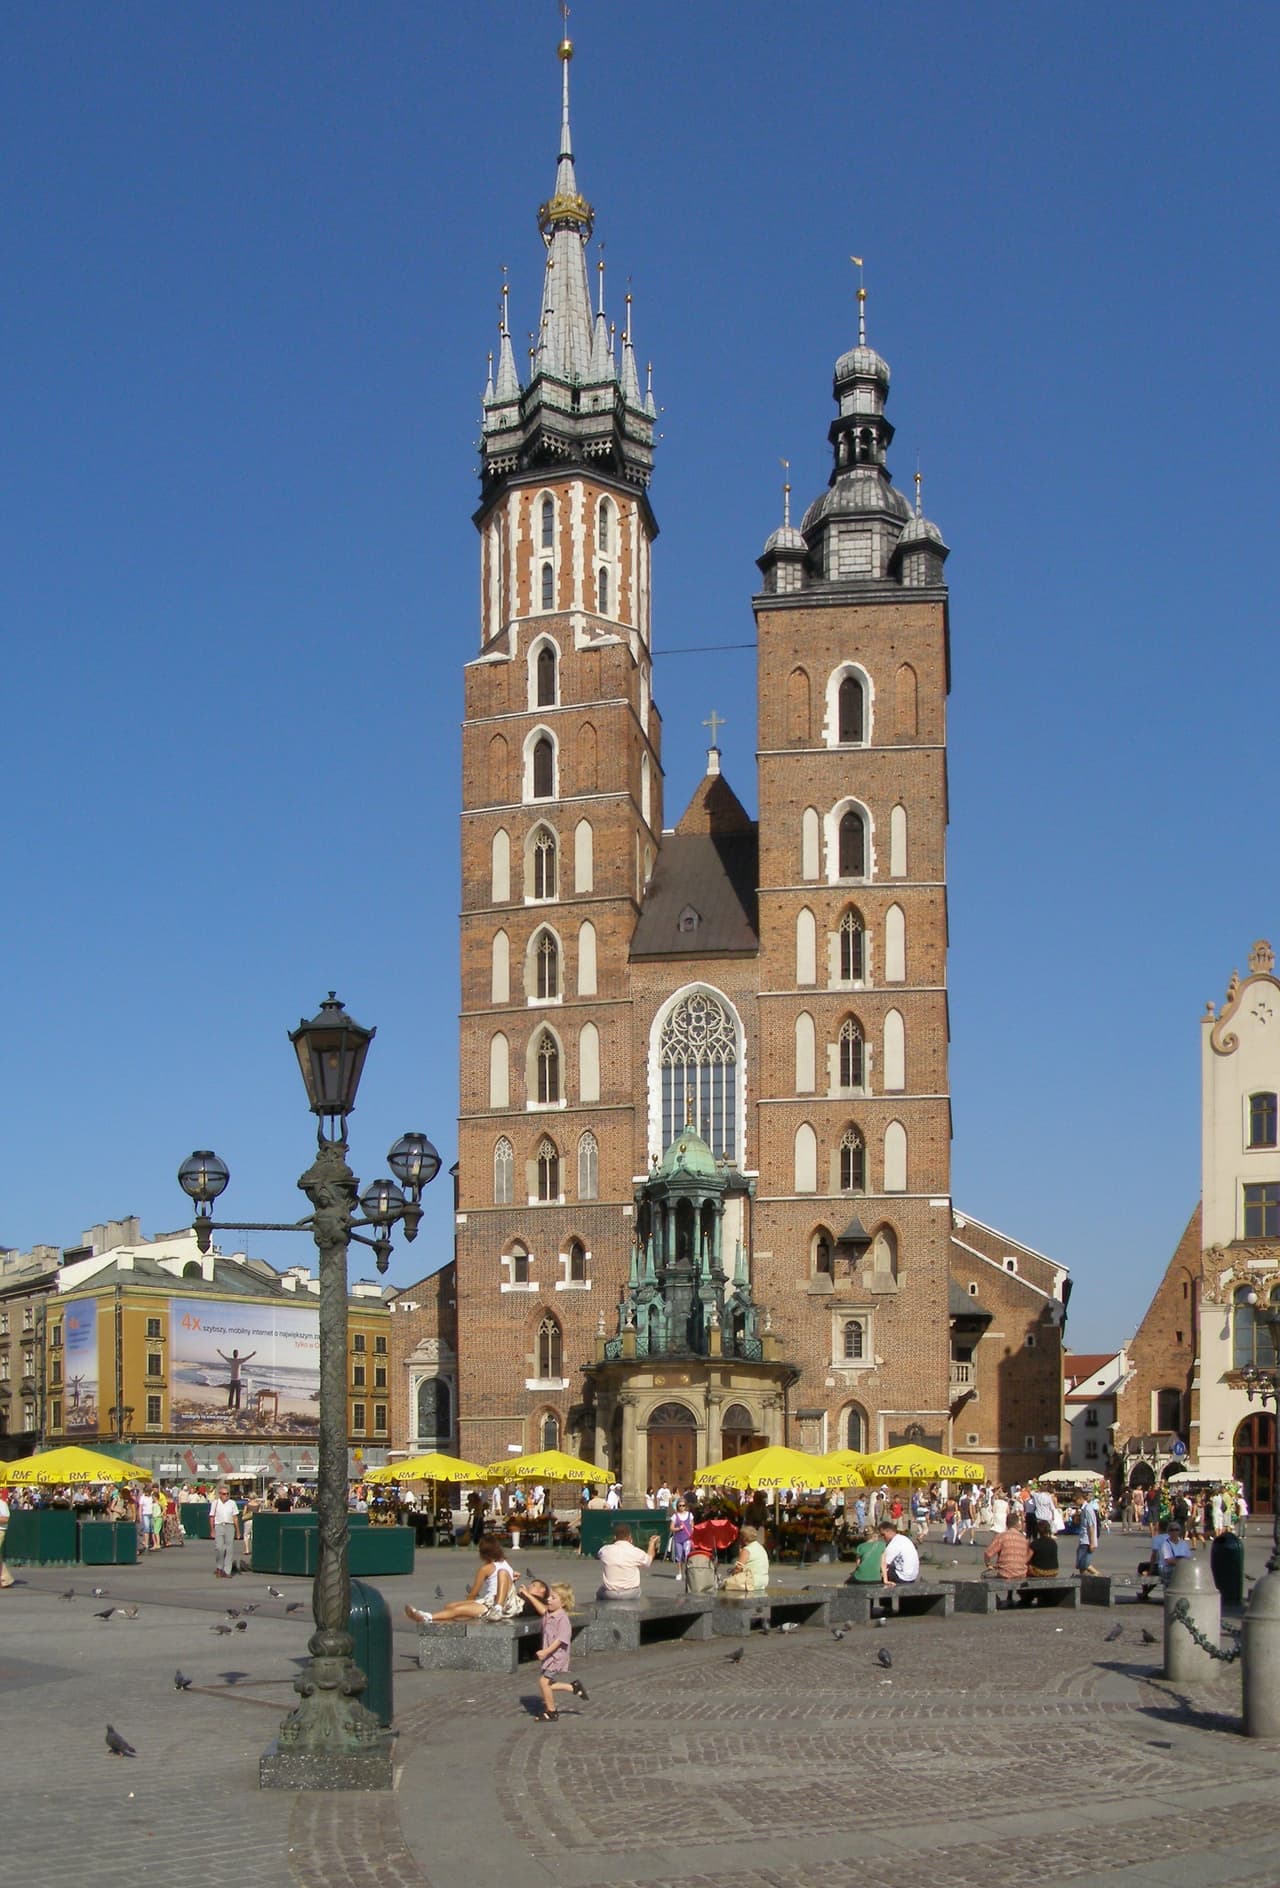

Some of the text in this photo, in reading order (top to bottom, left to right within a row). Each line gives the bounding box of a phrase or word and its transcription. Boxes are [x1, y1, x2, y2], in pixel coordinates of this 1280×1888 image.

[876, 1465, 902, 1475] RMF
[939, 1466, 960, 1476] RMF
[758, 1478, 784, 1487] RMF
